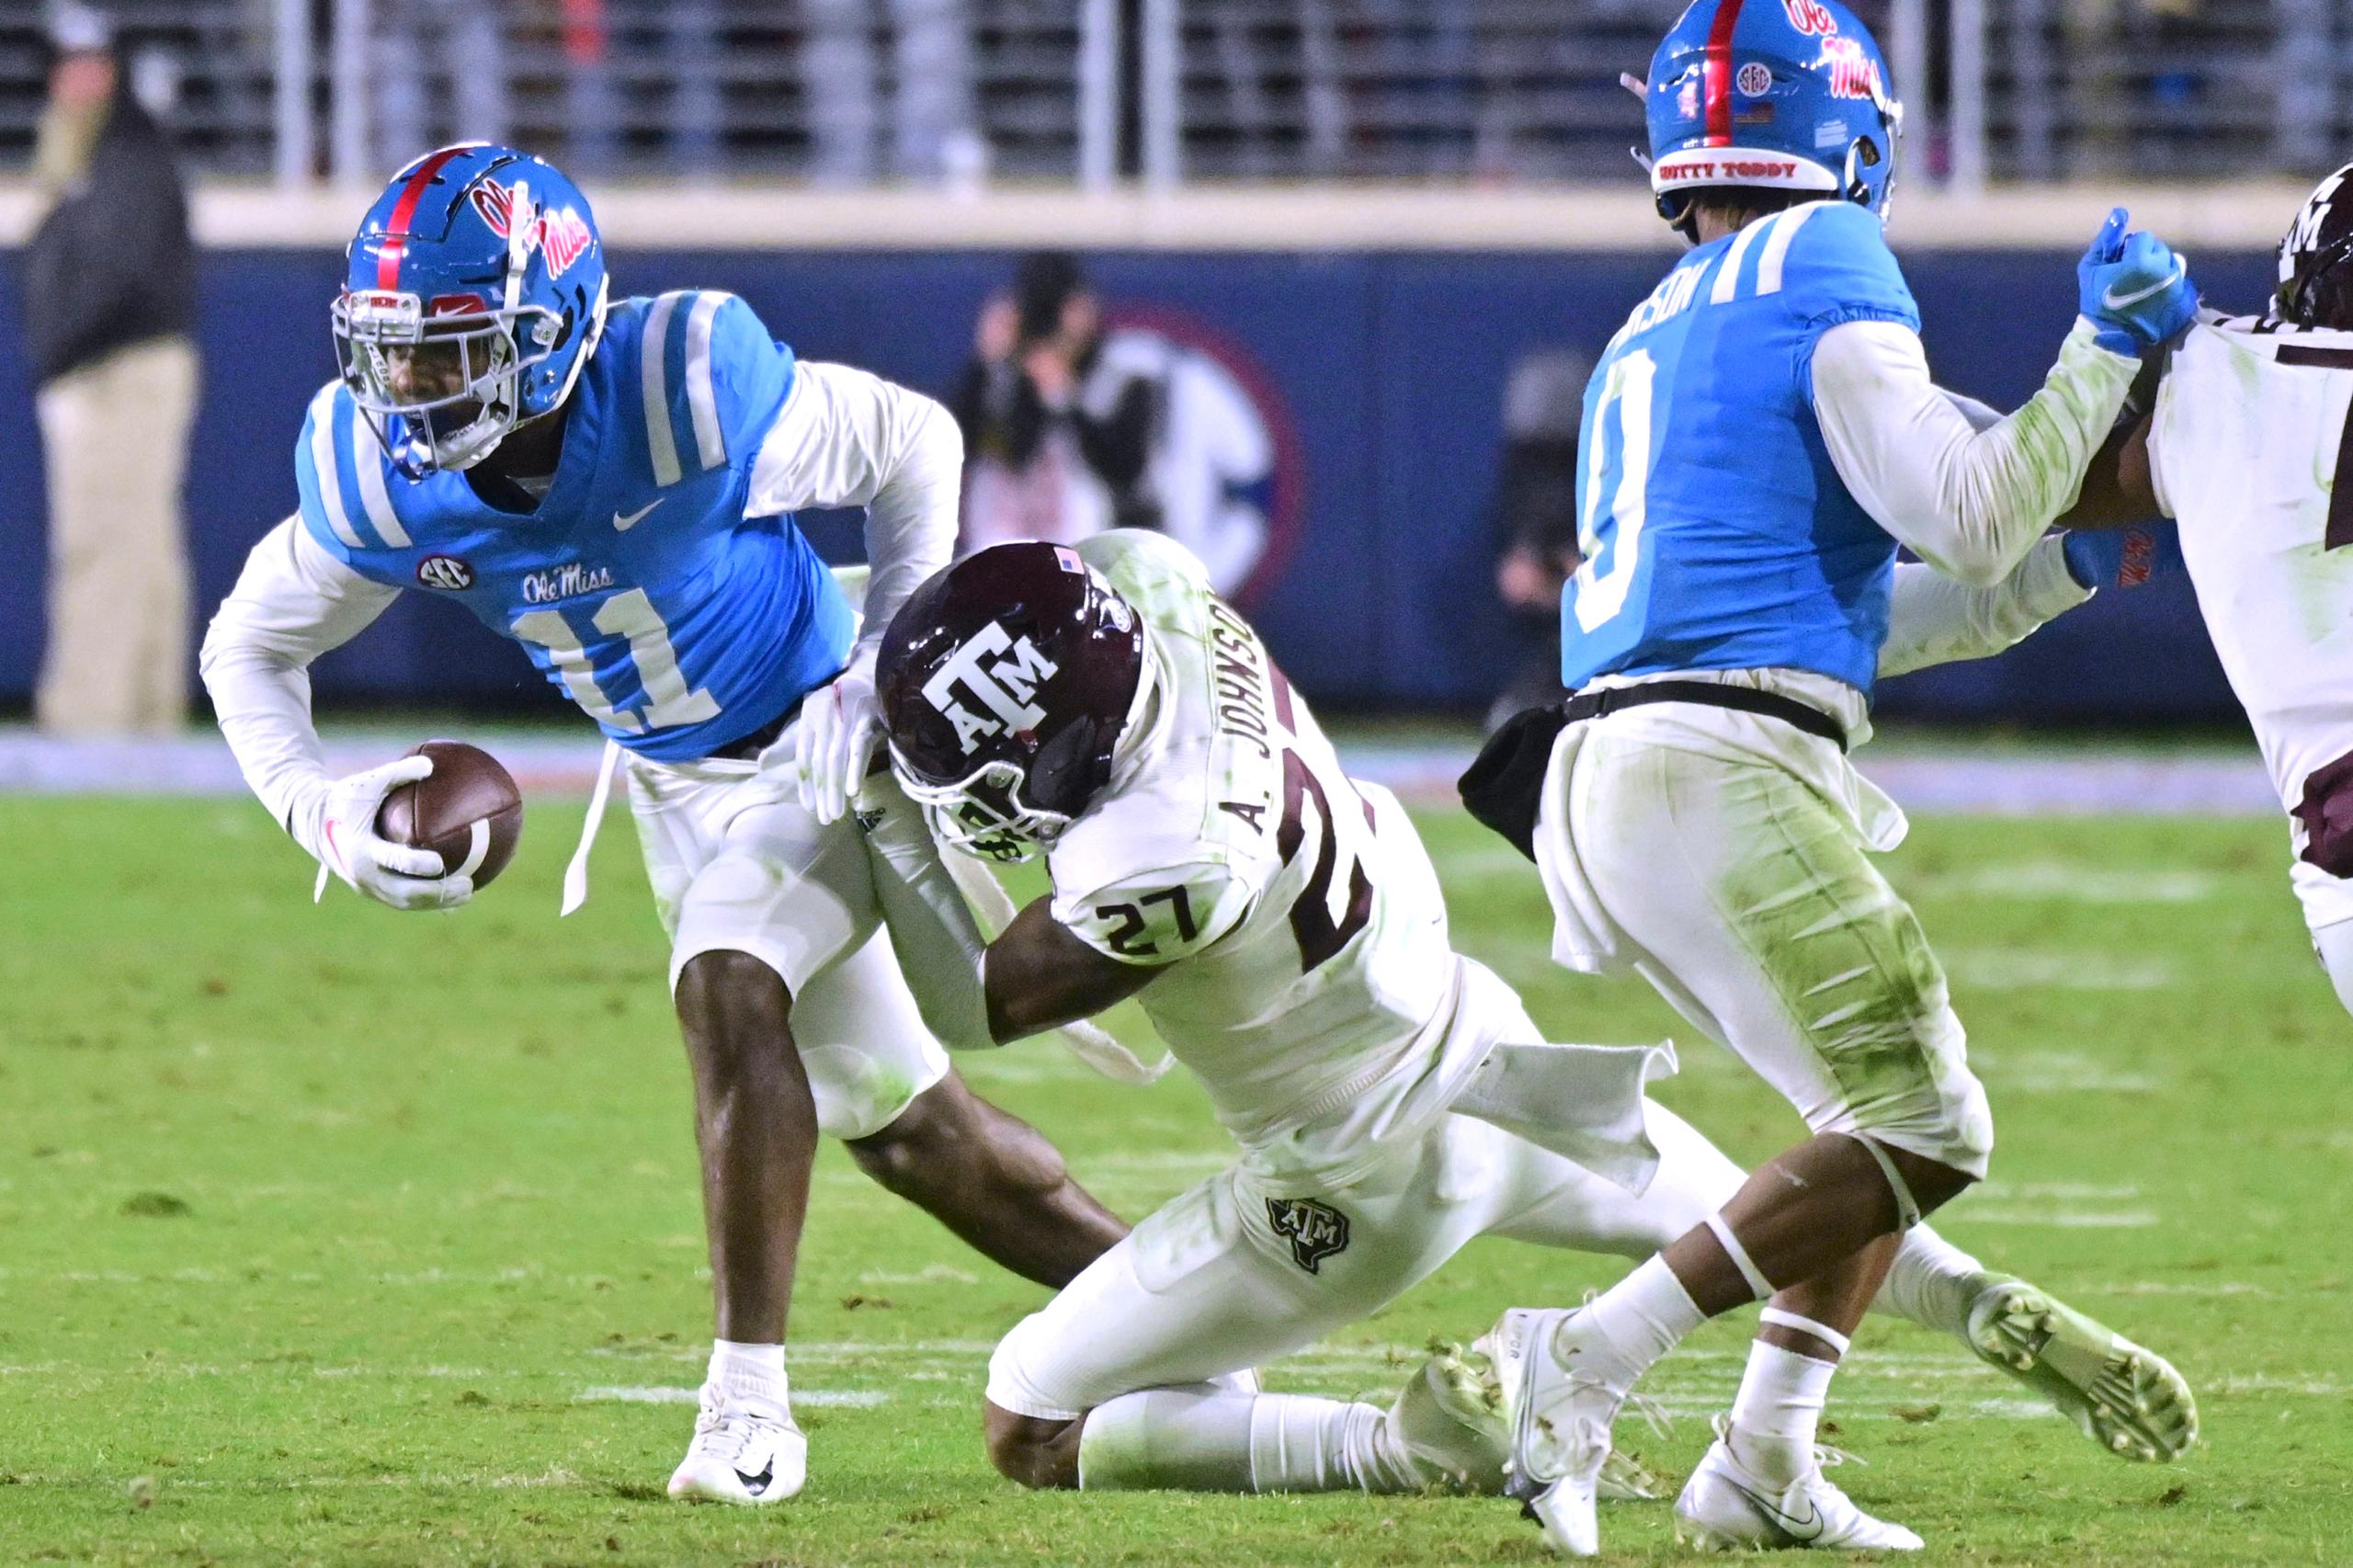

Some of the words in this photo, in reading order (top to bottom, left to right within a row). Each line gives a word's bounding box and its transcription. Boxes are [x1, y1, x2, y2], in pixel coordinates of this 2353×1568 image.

[1738, 64, 1770, 95] SEC
[1722, 161, 1797, 178] TODDY
[470, 178, 534, 239] Ol
[1574, 349, 1656, 634] 0
[419, 557, 472, 589] SEC
[523, 574, 557, 603] Ole
[557, 562, 614, 596] Miss
[510, 587, 722, 735] 11
[1206, 585, 1270, 759] JOHNSO
[1218, 790, 1270, 836] A.
[1096, 884, 1197, 956] 27
